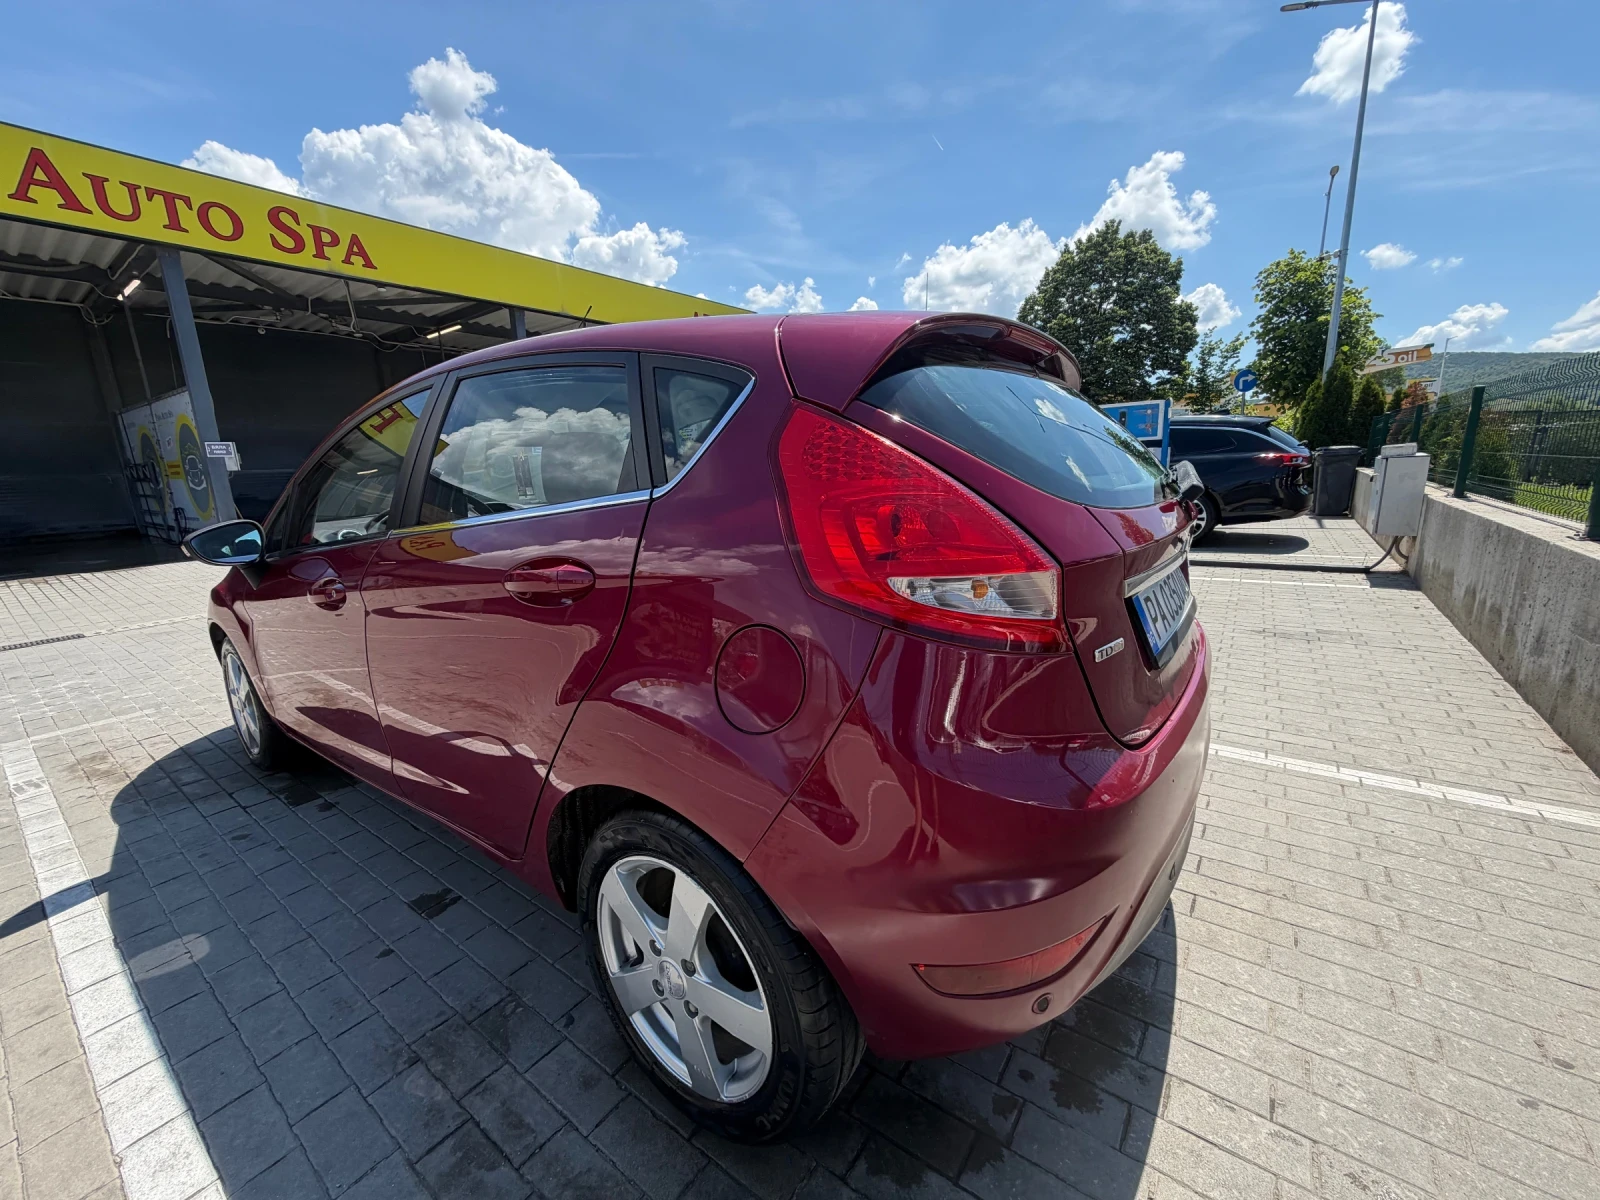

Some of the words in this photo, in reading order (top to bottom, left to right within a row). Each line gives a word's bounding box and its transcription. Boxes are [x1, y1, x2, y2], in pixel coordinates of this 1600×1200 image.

[8, 147, 244, 242] AUTO
[267, 206, 377, 270] SPA
[1398, 351, 1417, 363] oil
